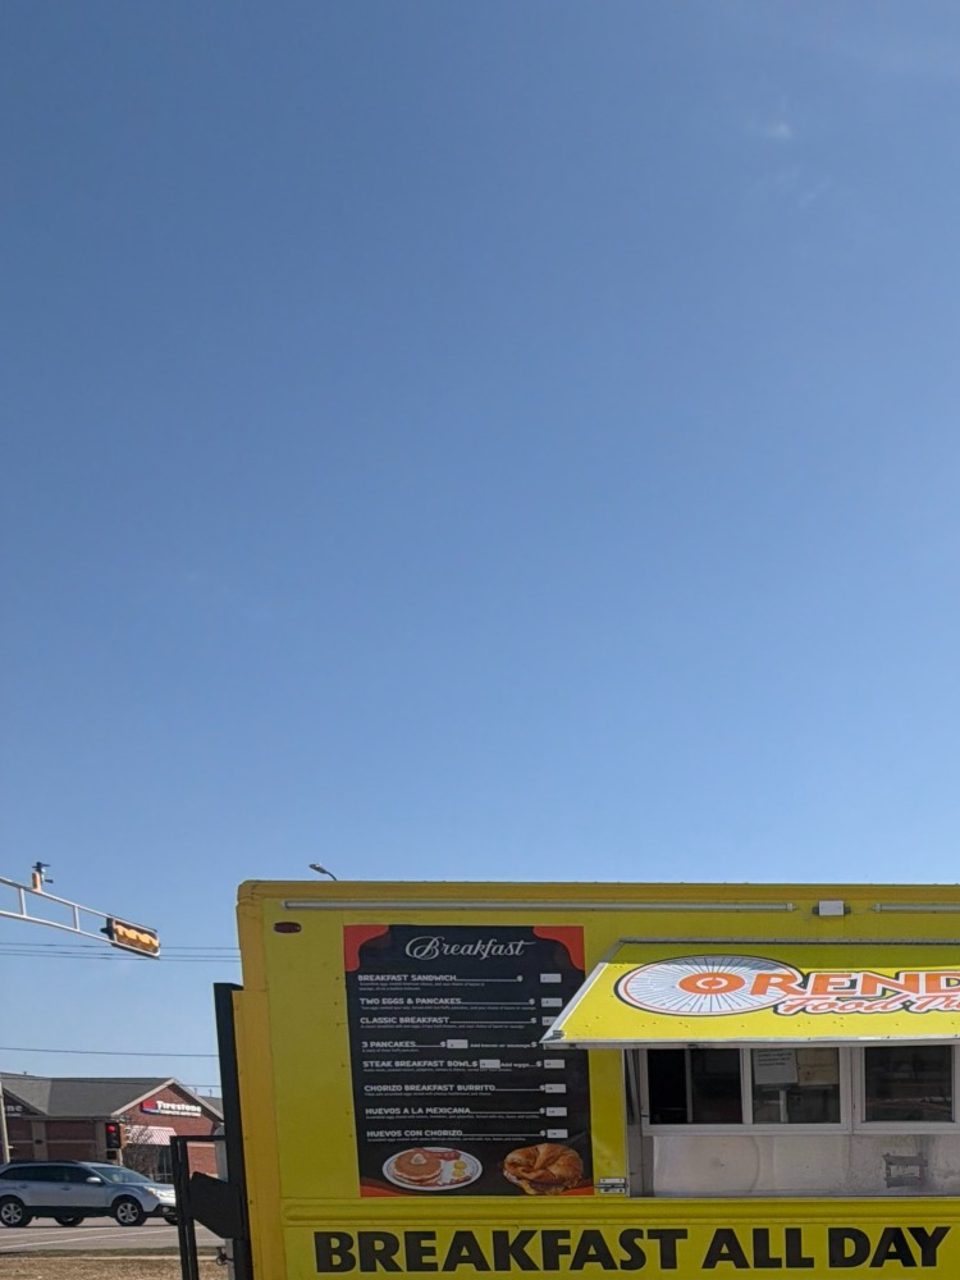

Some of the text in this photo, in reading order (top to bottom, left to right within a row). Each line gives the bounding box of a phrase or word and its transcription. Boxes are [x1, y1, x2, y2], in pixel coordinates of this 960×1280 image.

[405, 935, 536, 960] Breakfast
[358, 974, 409, 982] BREAKFAST
[411, 974, 457, 982] SANDWICH
[362, 1060, 393, 1068] STEAK
[394, 1060, 445, 1068] BREAKFAST
[364, 1084, 403, 1092] CHORIZO
[404, 1084, 455, 1092] BREAKFAST
[365, 1107, 401, 1115] HUEVOS
[313, 1226, 952, 1273] BREAKFAST ALL DAY
